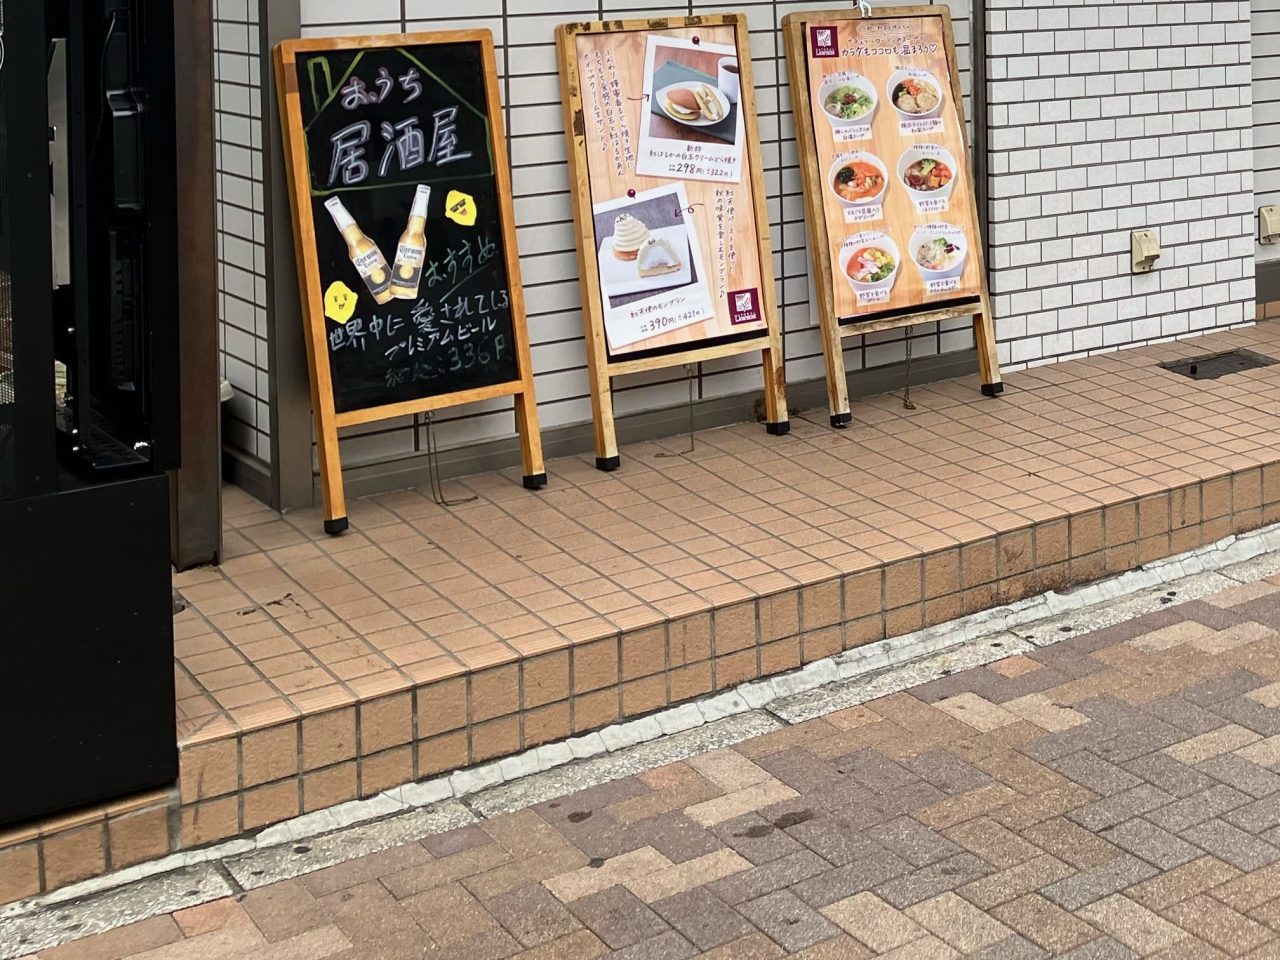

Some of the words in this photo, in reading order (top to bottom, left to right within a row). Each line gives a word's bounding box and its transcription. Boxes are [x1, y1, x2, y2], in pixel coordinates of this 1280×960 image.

[341, 66, 423, 111] おうち
[327, 105, 473, 187] 居酒屋
[355, 249, 378, 267] Corona
[399, 244, 423, 255] Corona
[425, 235, 497, 288] おすすめ
